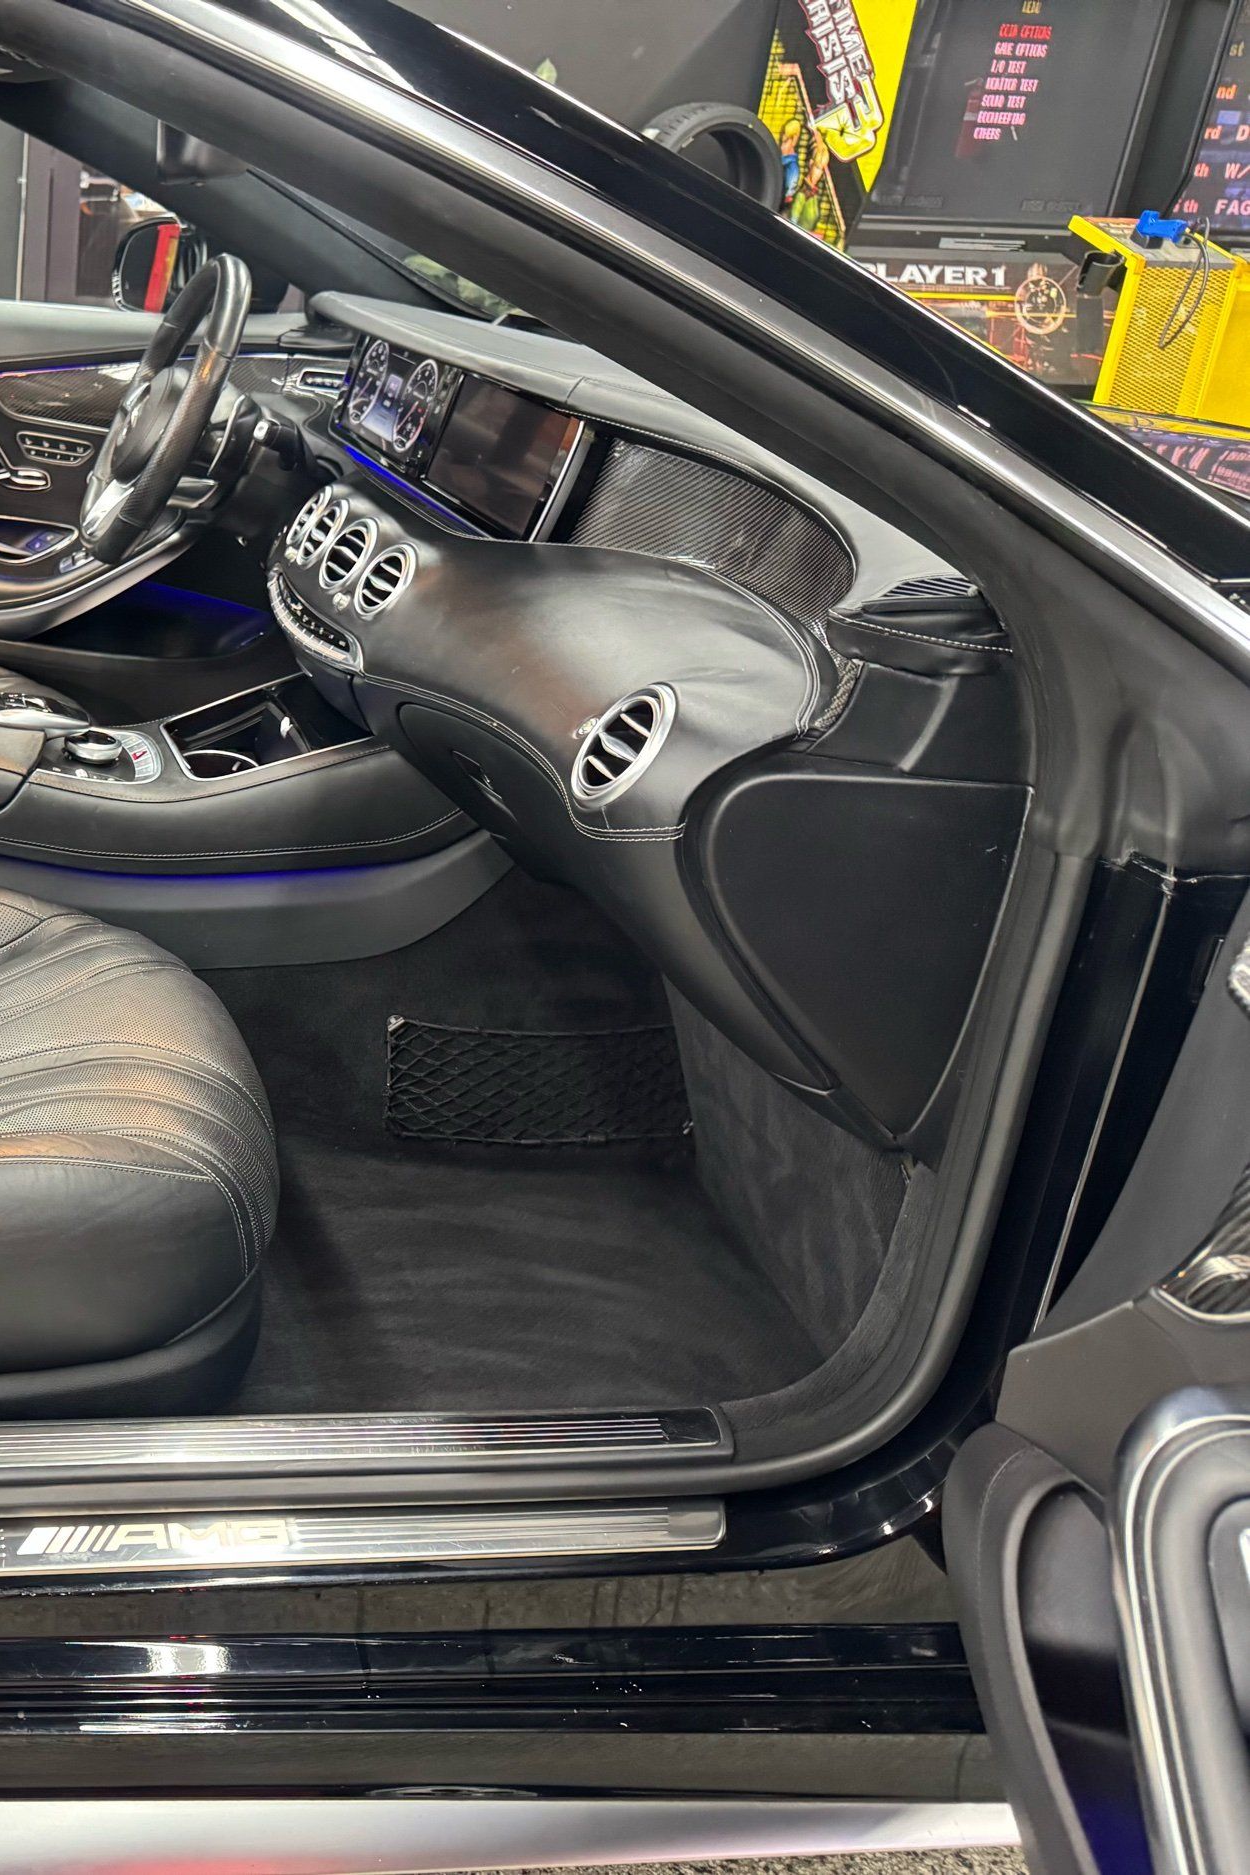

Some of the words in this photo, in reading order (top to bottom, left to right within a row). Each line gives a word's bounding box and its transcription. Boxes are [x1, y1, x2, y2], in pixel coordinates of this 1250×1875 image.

[1015, 43, 1048, 57] OPTIONS
[1007, 61, 1027, 74] TEST
[1019, 78, 1039, 92] TEST
[1007, 95, 1026, 109] TEST
[973, 127, 1002, 140] OTHERS
[103, 1519, 291, 1552] AMG
